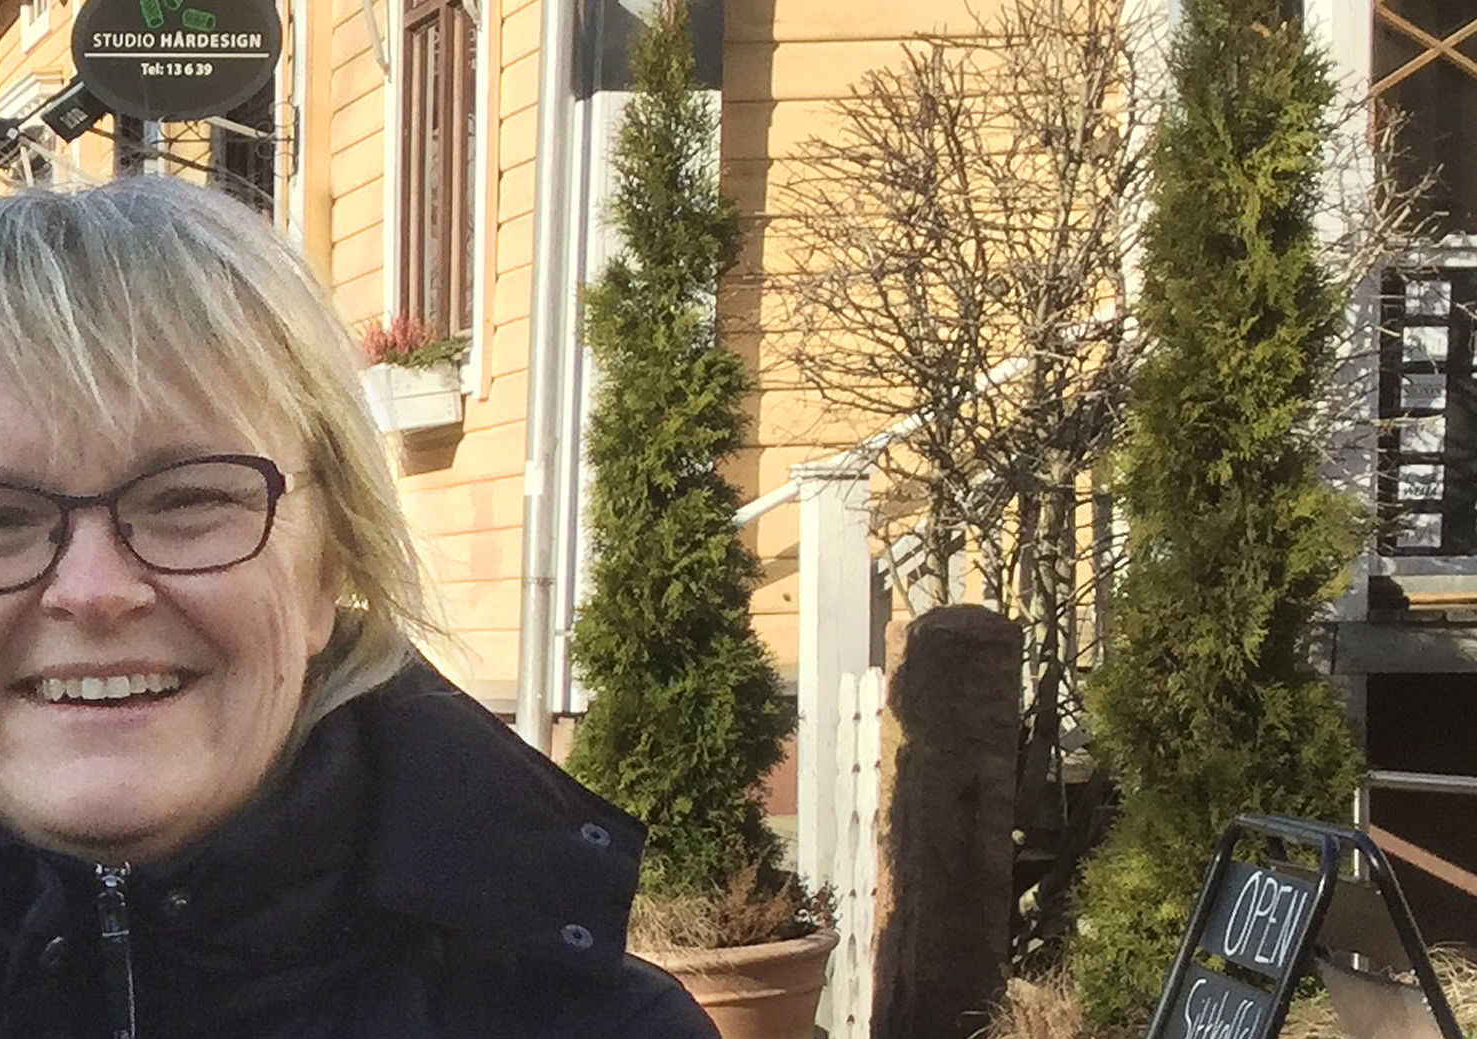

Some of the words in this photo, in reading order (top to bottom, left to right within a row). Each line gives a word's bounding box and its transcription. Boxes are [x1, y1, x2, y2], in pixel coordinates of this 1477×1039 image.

[93, 32, 156, 48] STUDIO
[160, 30, 262, 48] HÅRDESIGN
[140, 62, 164, 76] Tel:
[1223, 870, 1308, 967] OPEN
